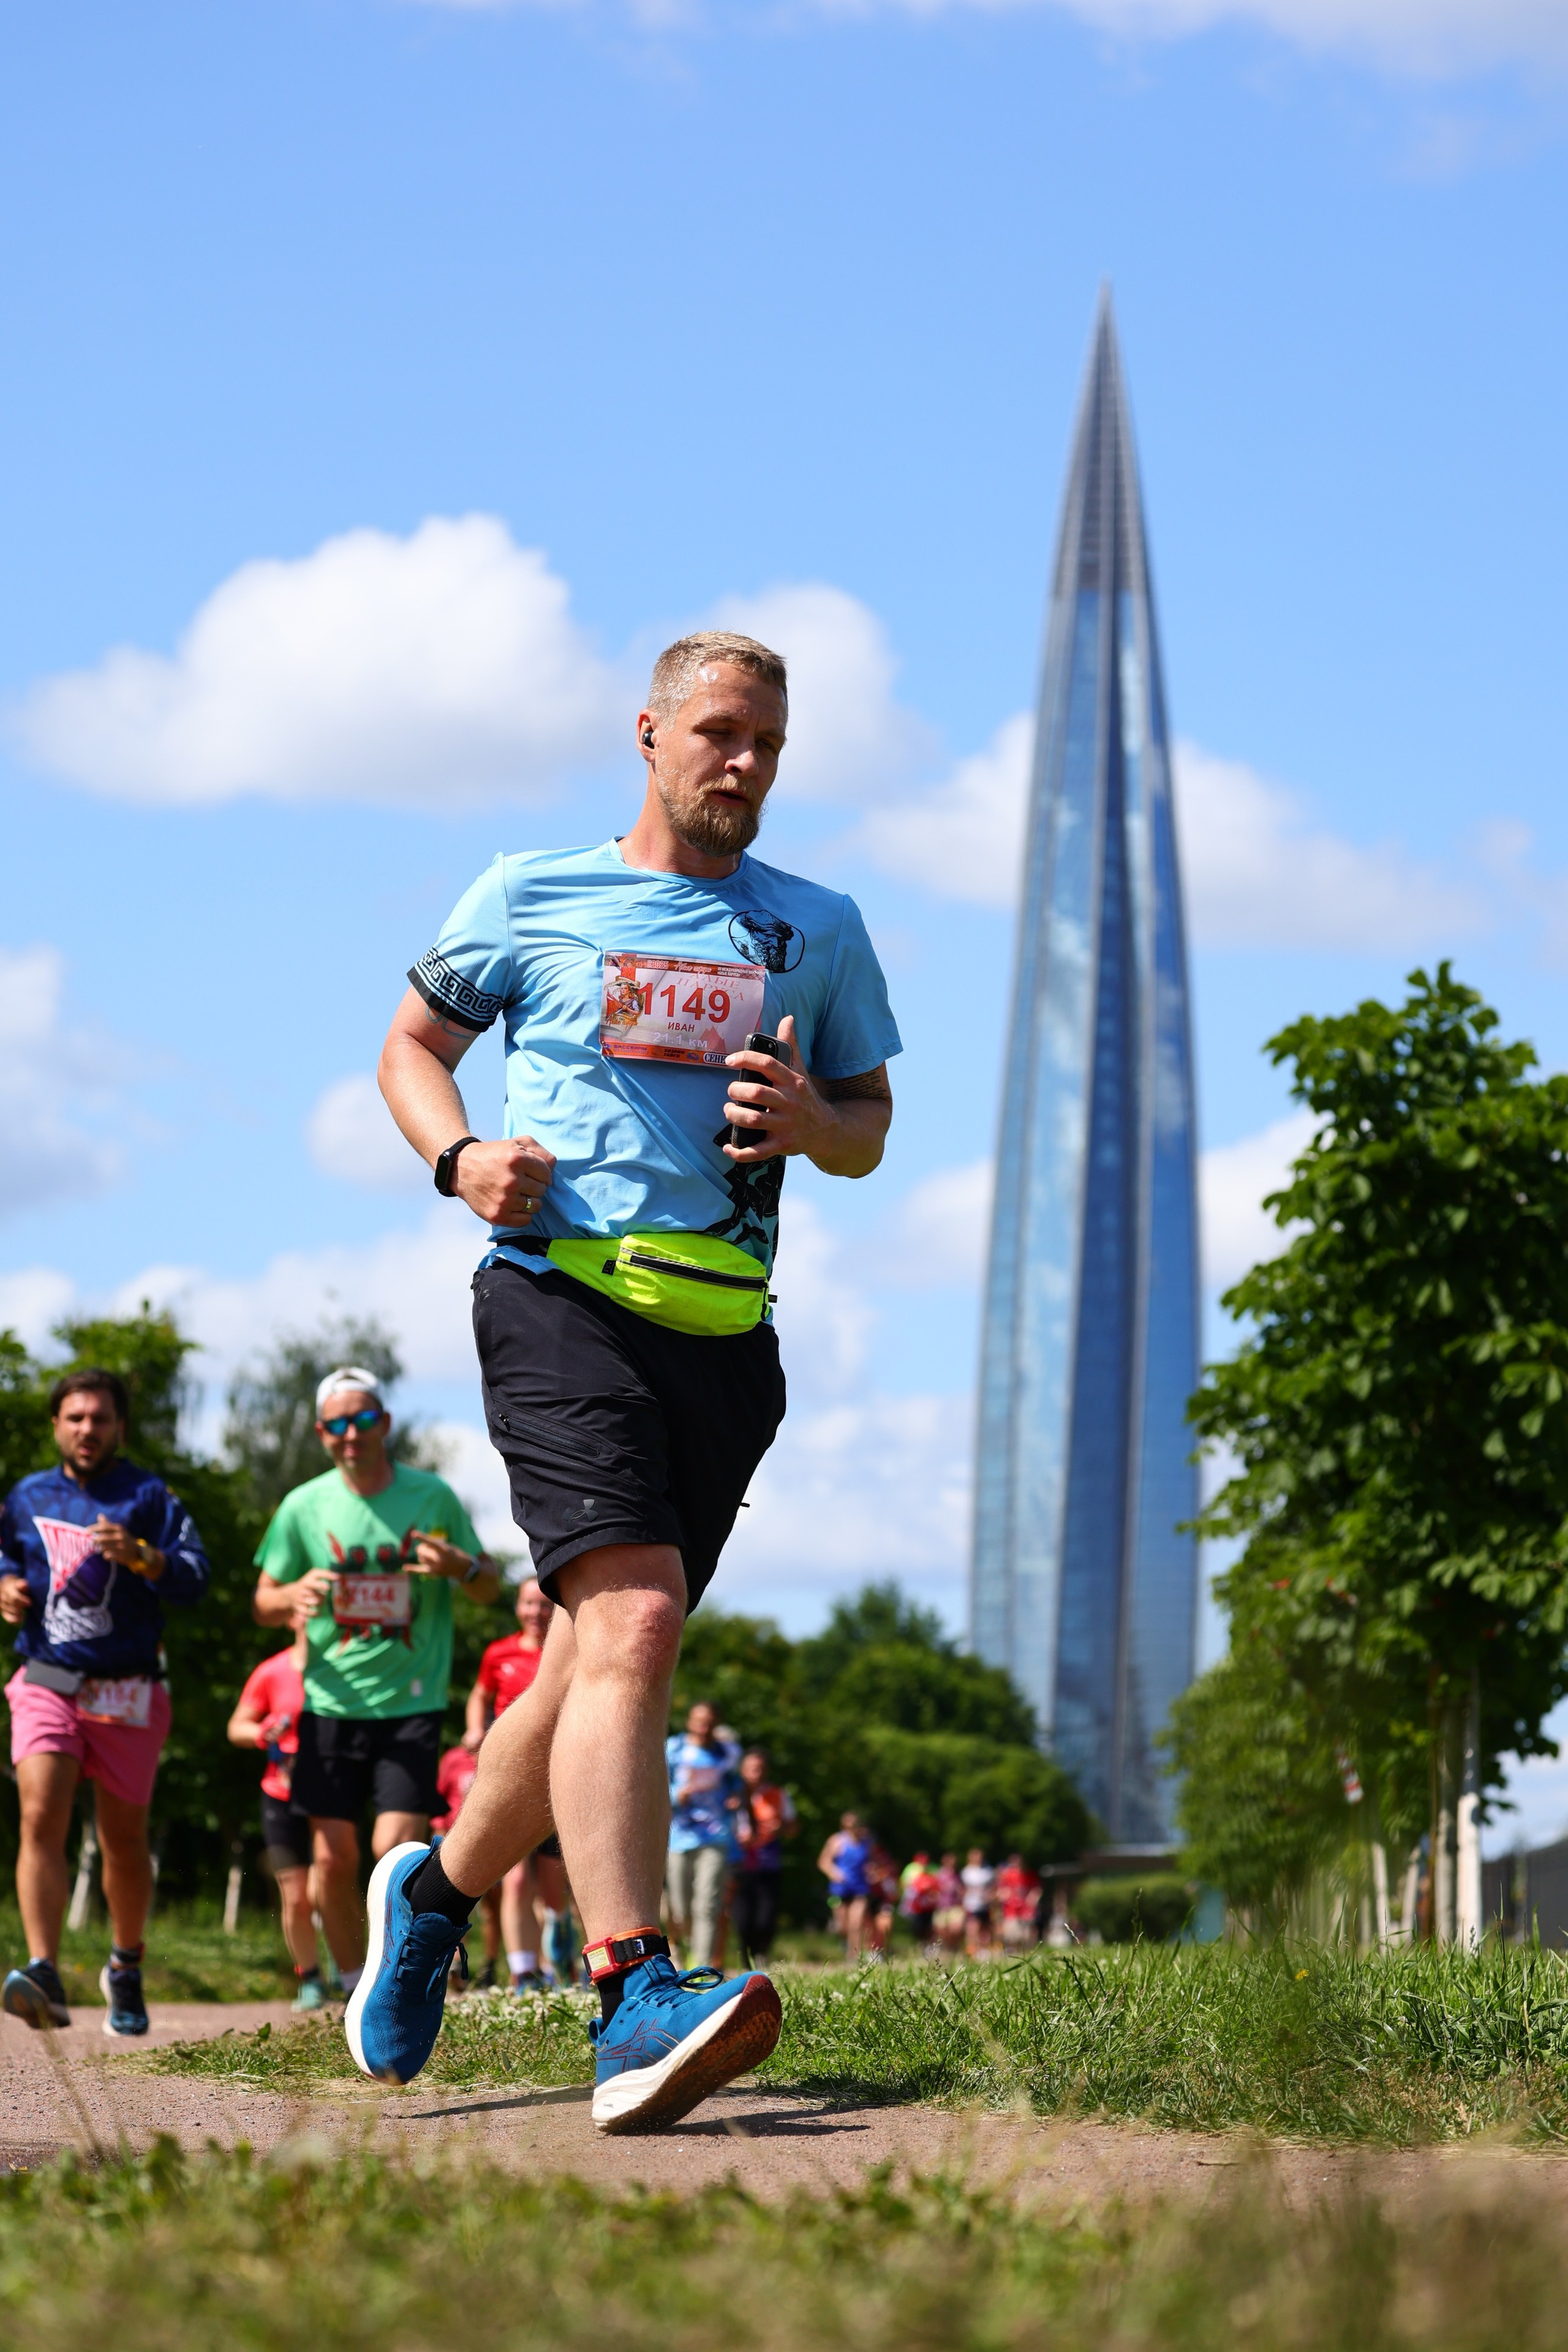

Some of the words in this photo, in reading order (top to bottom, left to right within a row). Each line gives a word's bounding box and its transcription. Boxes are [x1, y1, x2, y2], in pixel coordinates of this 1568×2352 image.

[651, 960, 669, 970] 2025
[690, 973, 740, 989] АЛЫЕ
[637, 982, 731, 1023] 1149
[668, 1022, 695, 1032] ИВАН
[653, 1032, 682, 1045] 21.1
[688, 1038, 707, 1048] км
[706, 1054, 726, 1063] СЕНЕ
